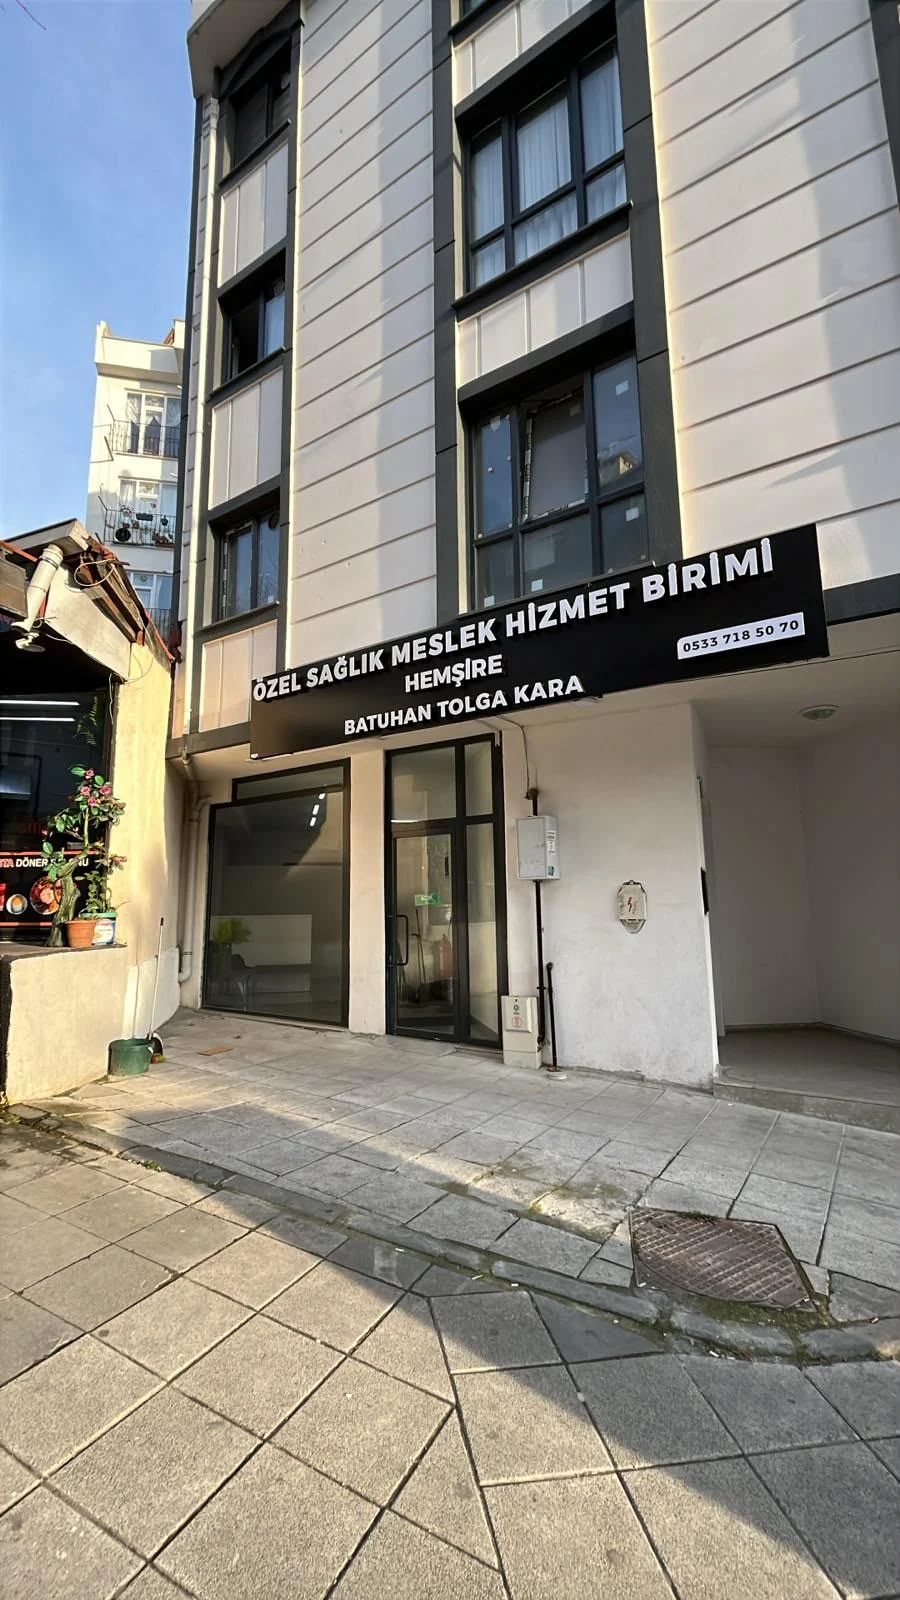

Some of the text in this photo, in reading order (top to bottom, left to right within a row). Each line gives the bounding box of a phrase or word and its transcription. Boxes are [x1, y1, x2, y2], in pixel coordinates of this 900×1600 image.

[253, 538, 773, 701] ÖZEL SAĞLIK MESLEK HİZMET BİRİMİ
[683, 620, 799, 652] 0533 718 50 70
[405, 654, 502, 693] HEMŞİRE
[345, 675, 583, 735] BATUHAN TOLGA KARA
[16, 857, 48, 868] DÖNER
